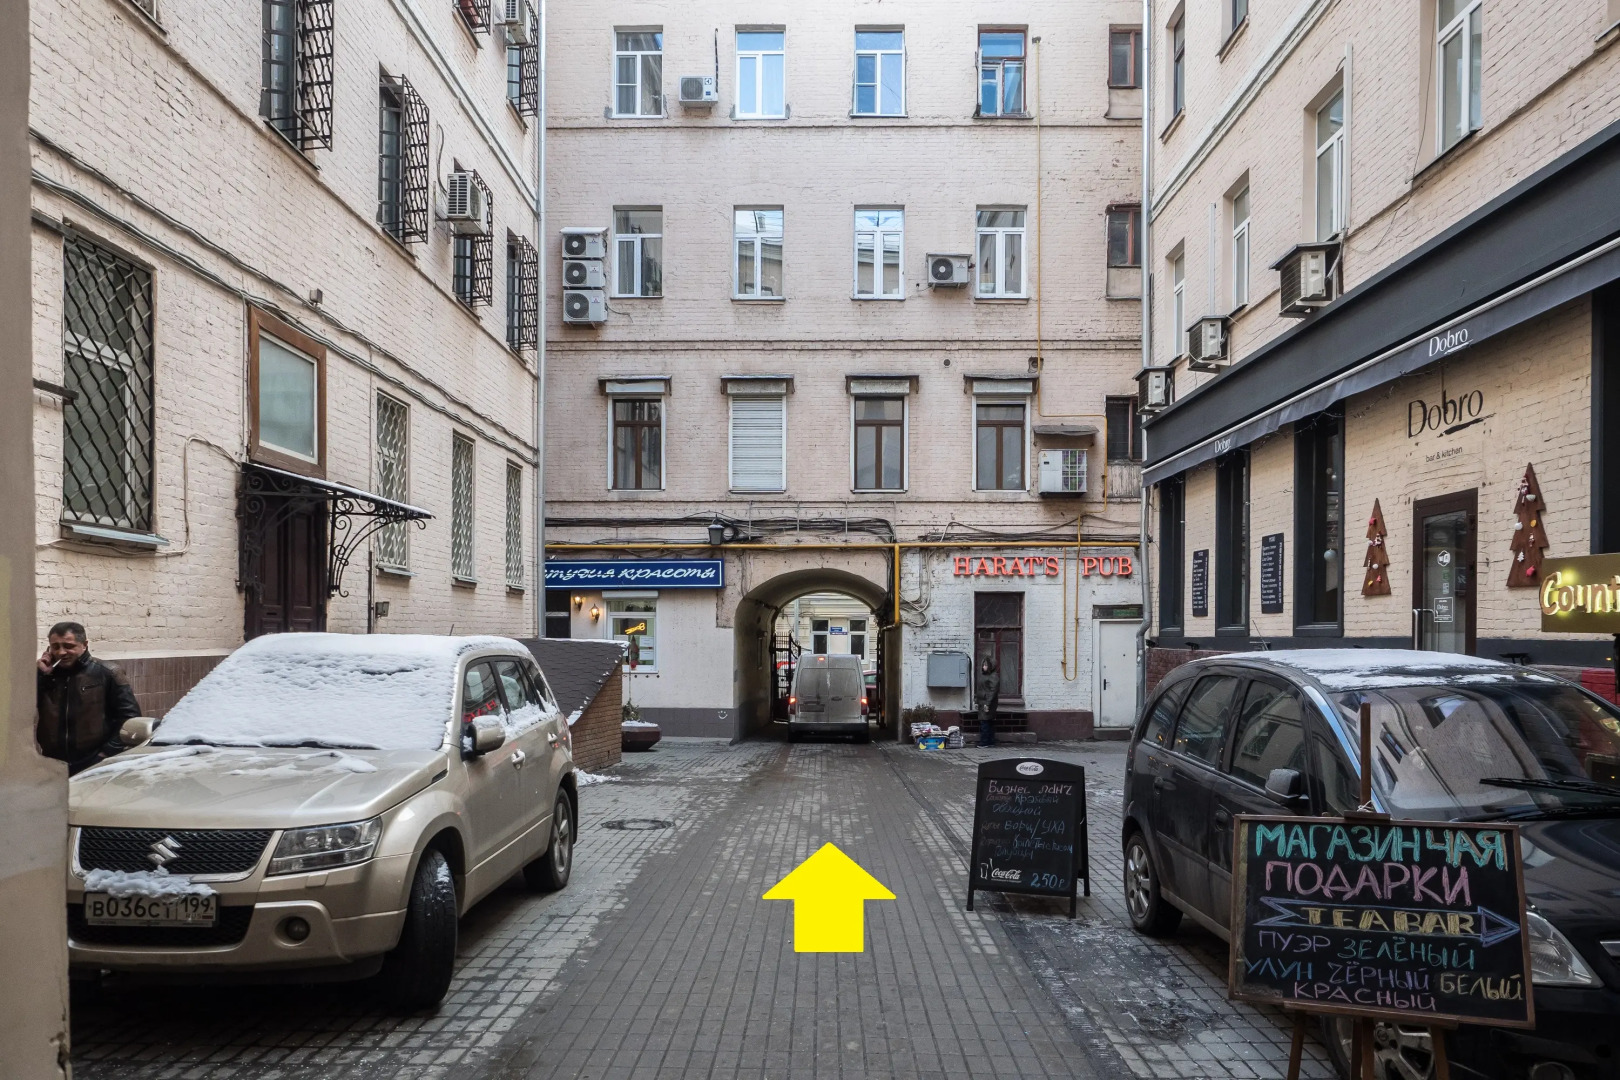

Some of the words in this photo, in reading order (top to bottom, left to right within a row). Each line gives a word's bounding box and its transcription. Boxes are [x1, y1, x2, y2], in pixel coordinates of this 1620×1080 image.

[1429, 329, 1468, 356] Dobro
[1408, 390, 1483, 438] Dobro
[1442, 447, 1462, 458] kitchen
[618, 568, 716, 580] красоты
[953, 556, 1059, 576] HARAT'S
[1082, 556, 1133, 576] PUB
[988, 780, 1030, 795] Бизнес
[1256, 823, 1420, 862] МАГАЗИН
[1425, 828, 1509, 871] ЧАЯ
[1265, 861, 1472, 906] ПОДАРКИ
[181, 897, 210, 913] 199
[1259, 930, 1331, 952] ПУЭР
[1337, 936, 1475, 970] ЗЕЛЁНЫЙ
[1243, 956, 1313, 980] УЛУН
[1327, 961, 1429, 990] ЧЁРНЫЙ
[1440, 973, 1524, 1000] БЕЛЫЙ
[1294, 981, 1437, 1011] КРАСНЫЙ
